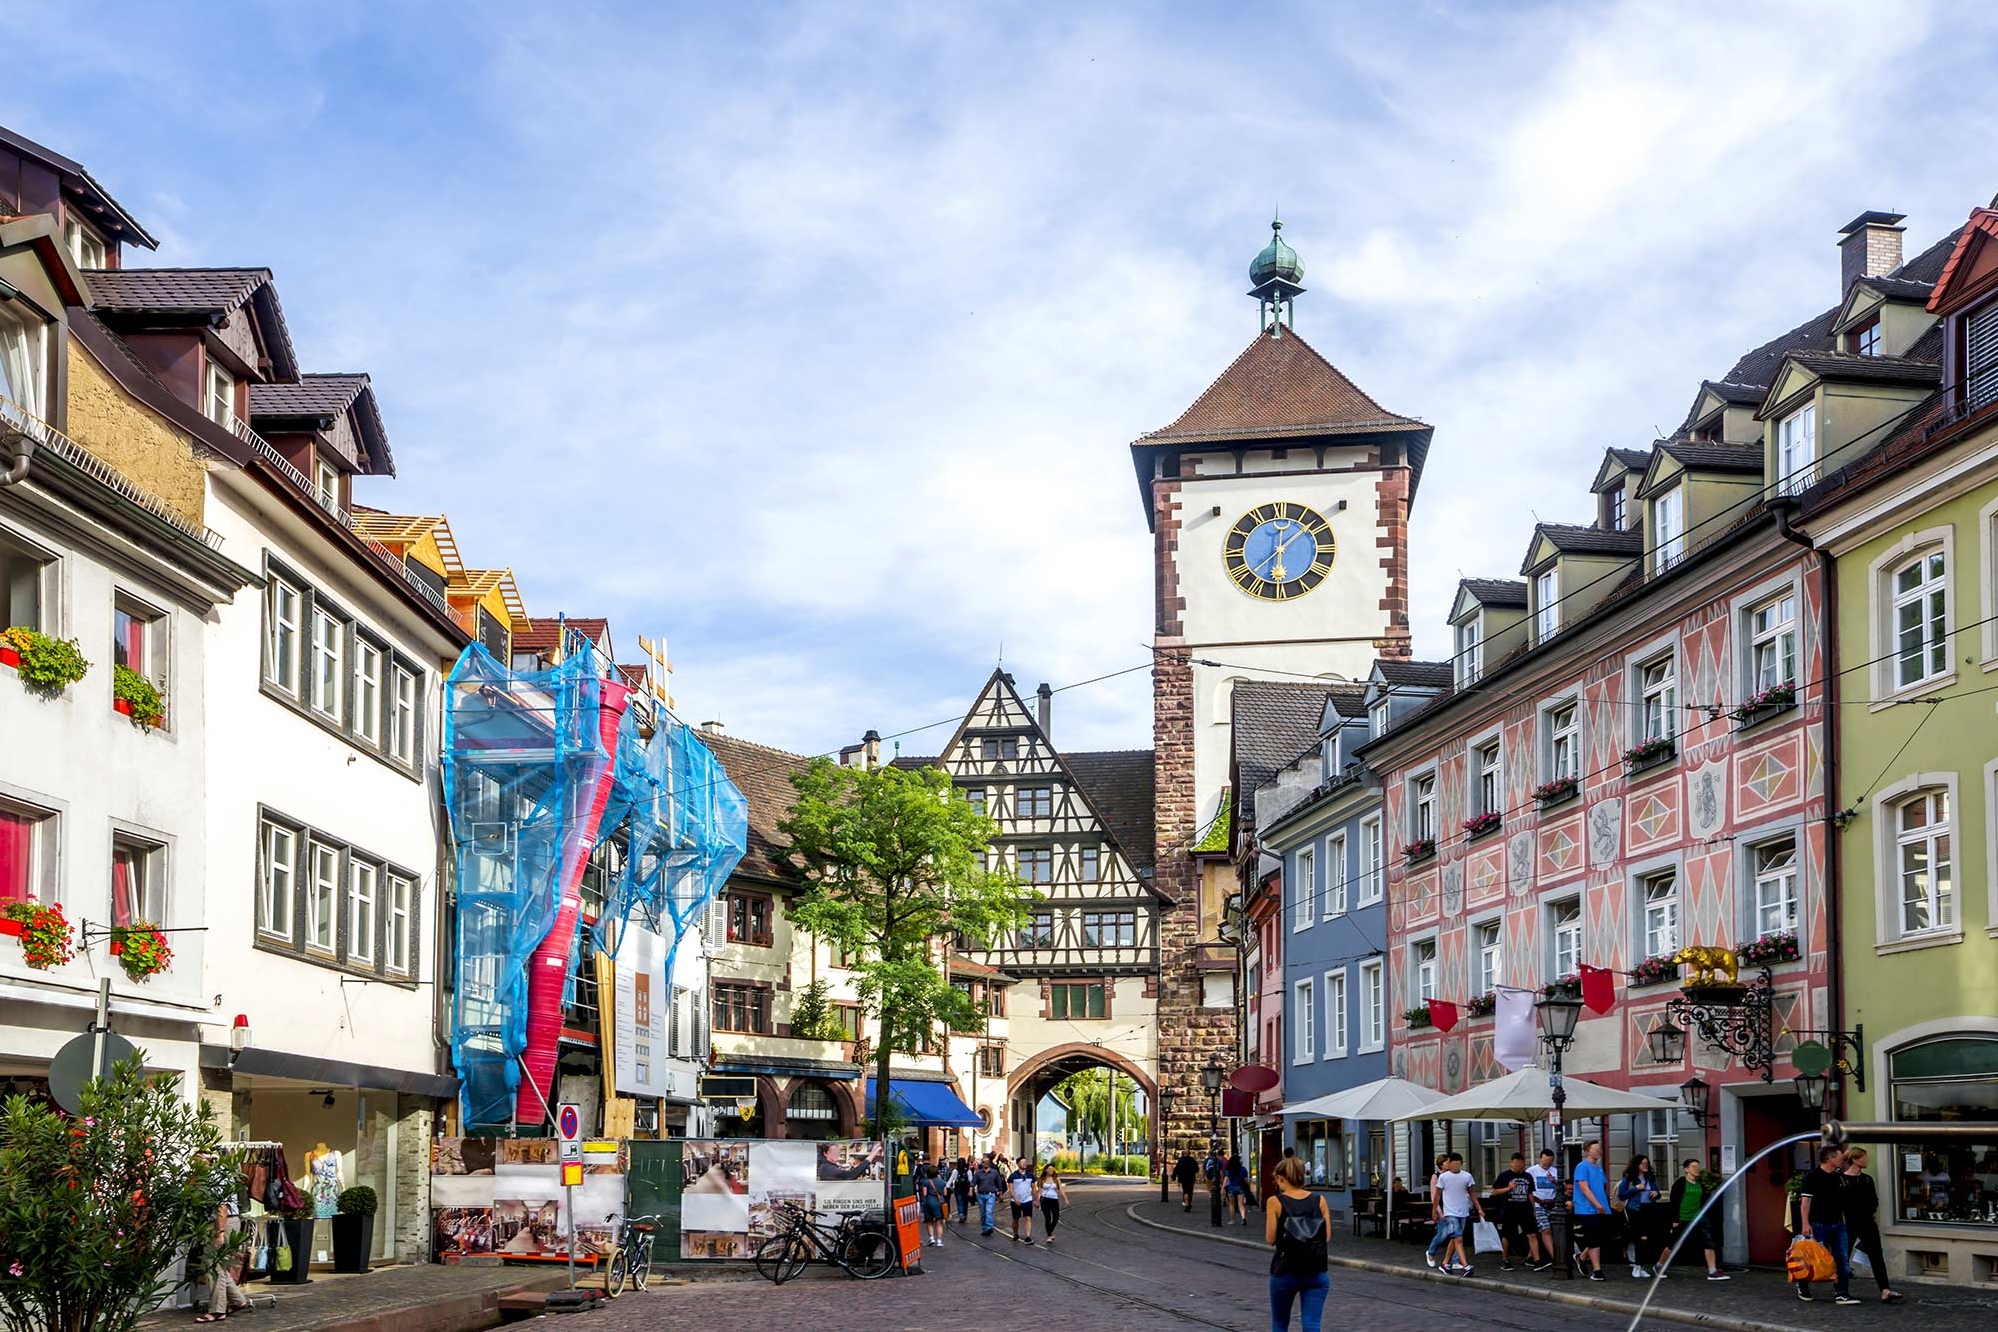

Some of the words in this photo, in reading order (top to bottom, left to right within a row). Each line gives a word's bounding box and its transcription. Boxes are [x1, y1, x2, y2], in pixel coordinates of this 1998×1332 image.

[1249, 509, 1266, 526] XI
[1273, 502, 1287, 519] XII
[1232, 526, 1250, 539] X
[1317, 544, 1336, 553] III
